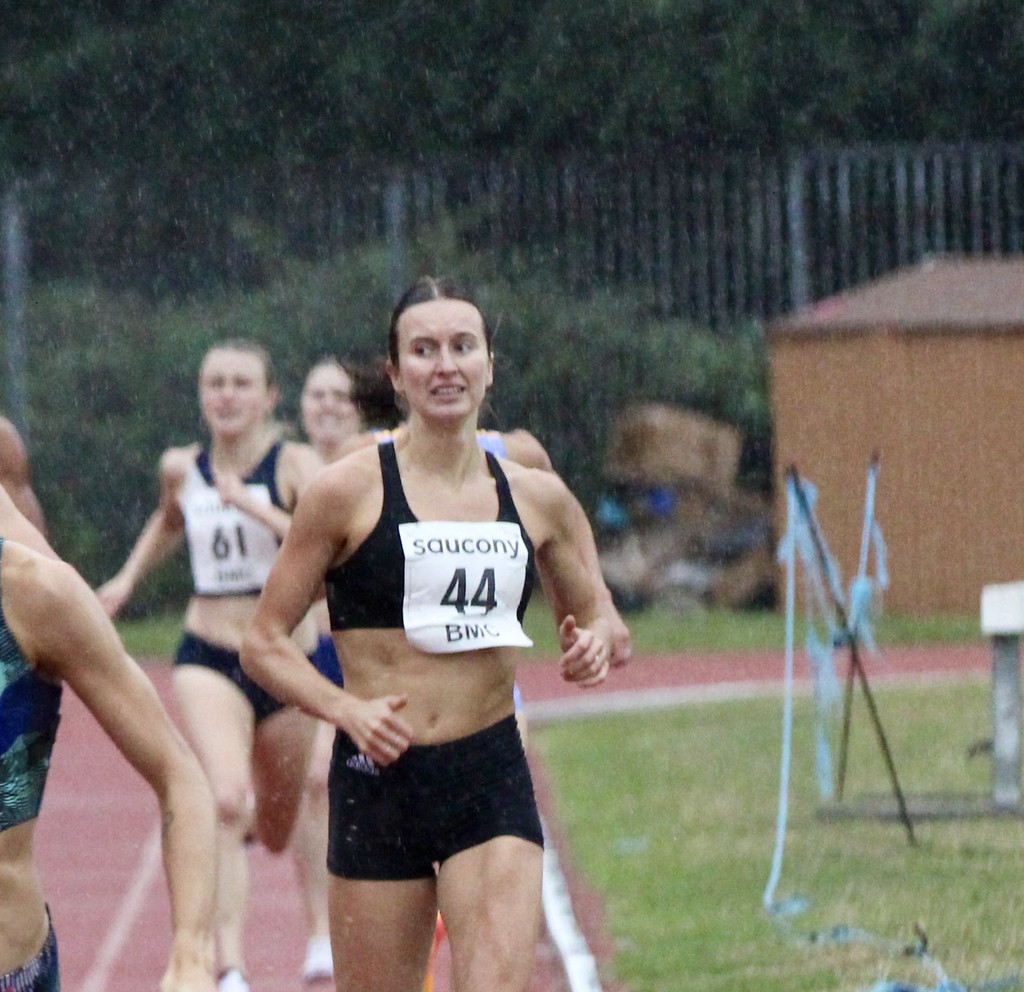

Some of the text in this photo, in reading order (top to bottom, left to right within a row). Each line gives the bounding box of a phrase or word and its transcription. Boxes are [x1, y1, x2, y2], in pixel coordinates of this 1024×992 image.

[213, 524, 247, 559] 61
[413, 538, 519, 559] saucony
[440, 568, 497, 615] 44
